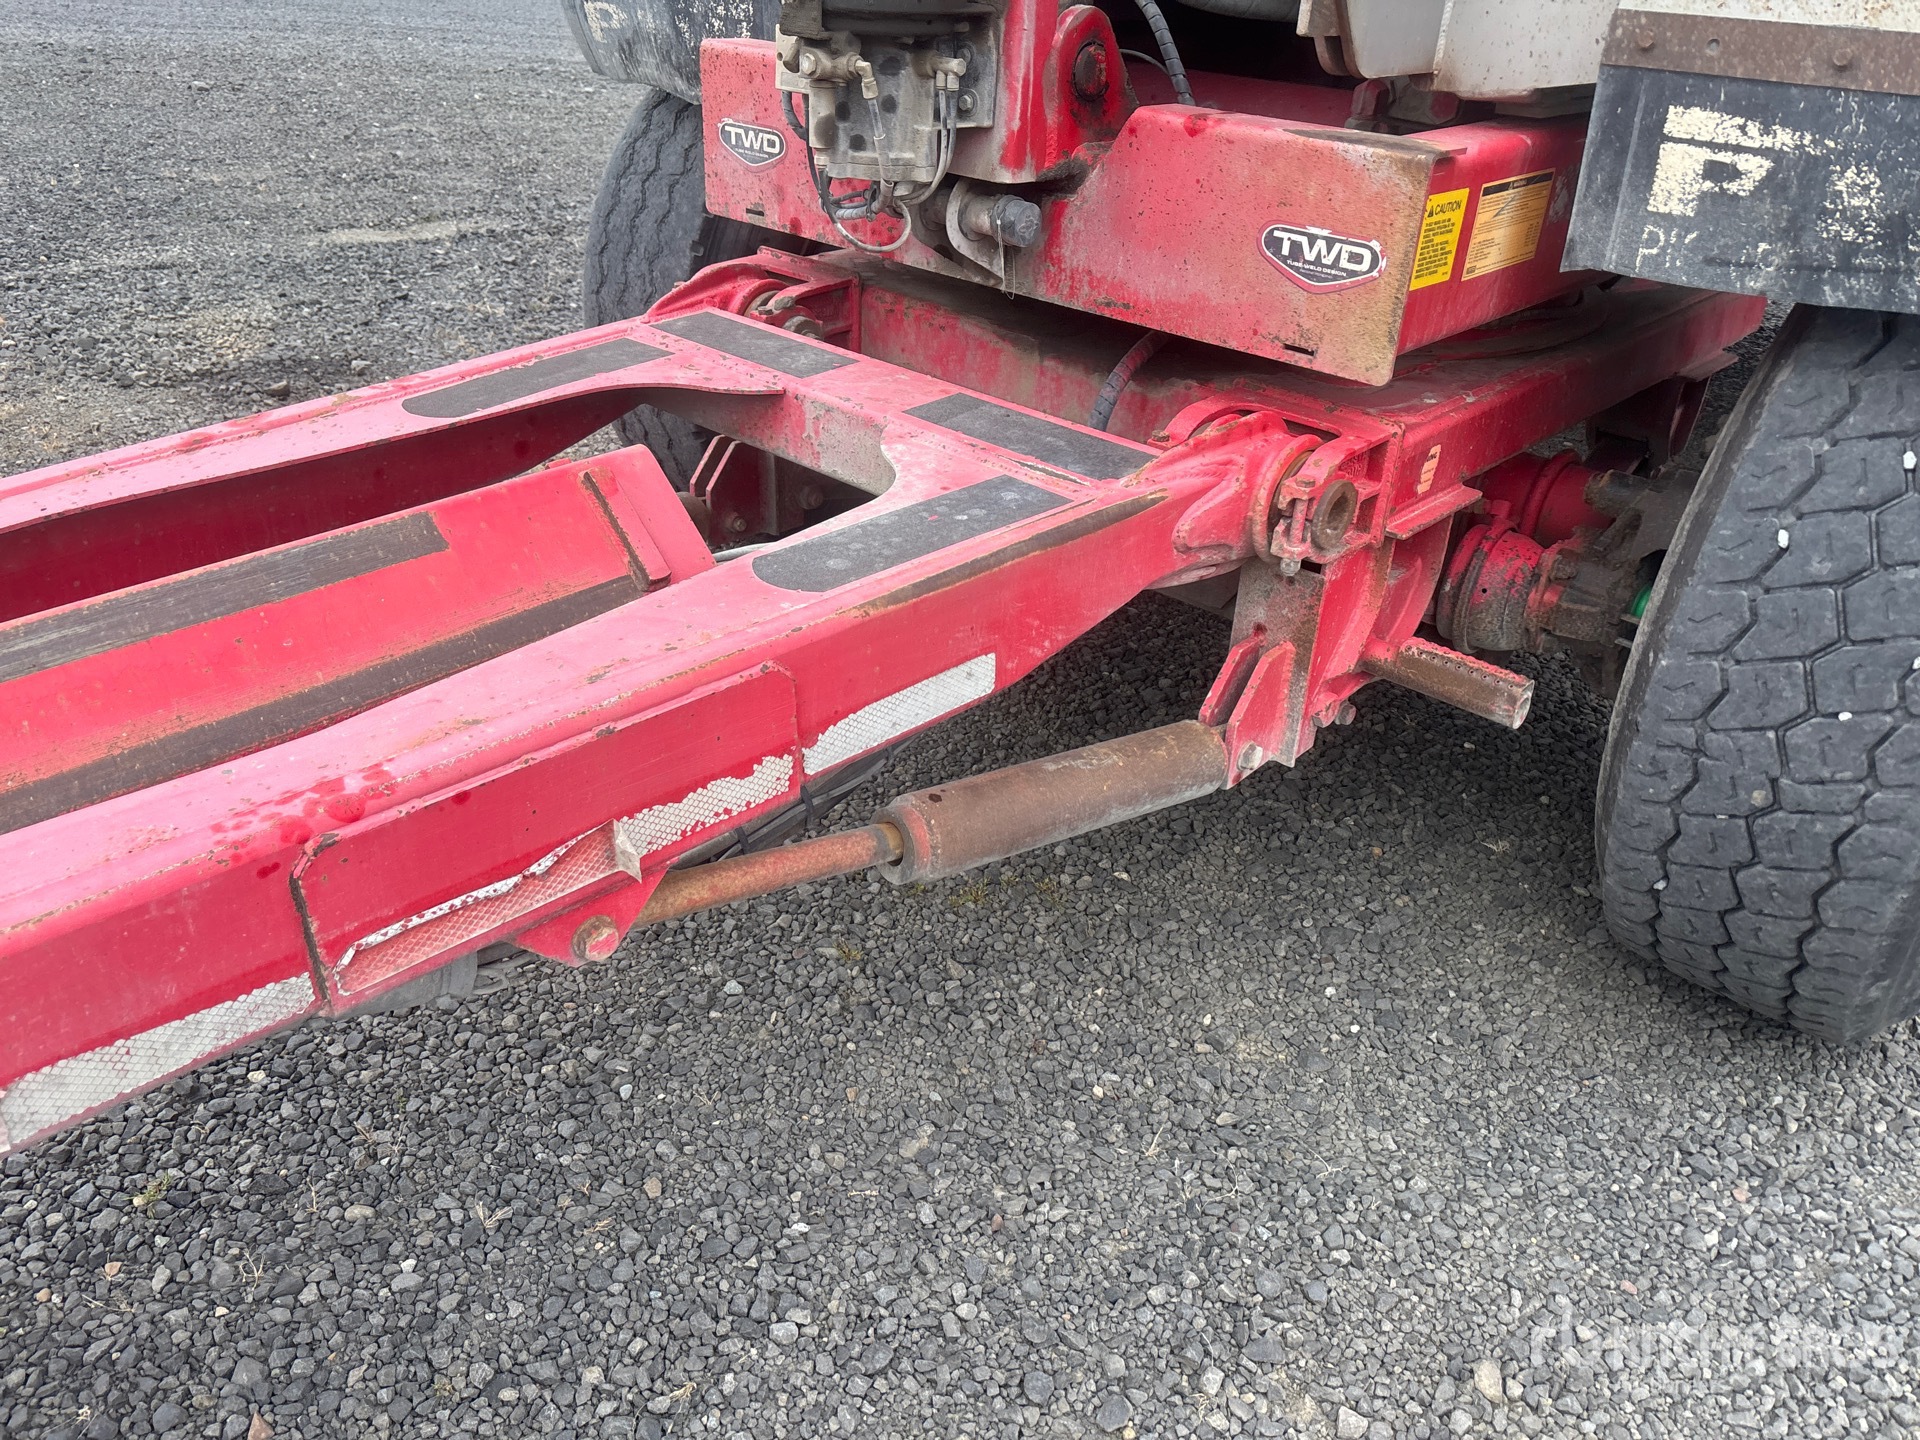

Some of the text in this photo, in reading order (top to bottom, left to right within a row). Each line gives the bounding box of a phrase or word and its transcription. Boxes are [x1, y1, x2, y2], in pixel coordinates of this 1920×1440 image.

[725, 126, 780, 153] TWD
[1435, 200, 1462, 215] CAUTION
[1273, 229, 1372, 272] TWD
[1322, 266, 1346, 277] DESIGN
